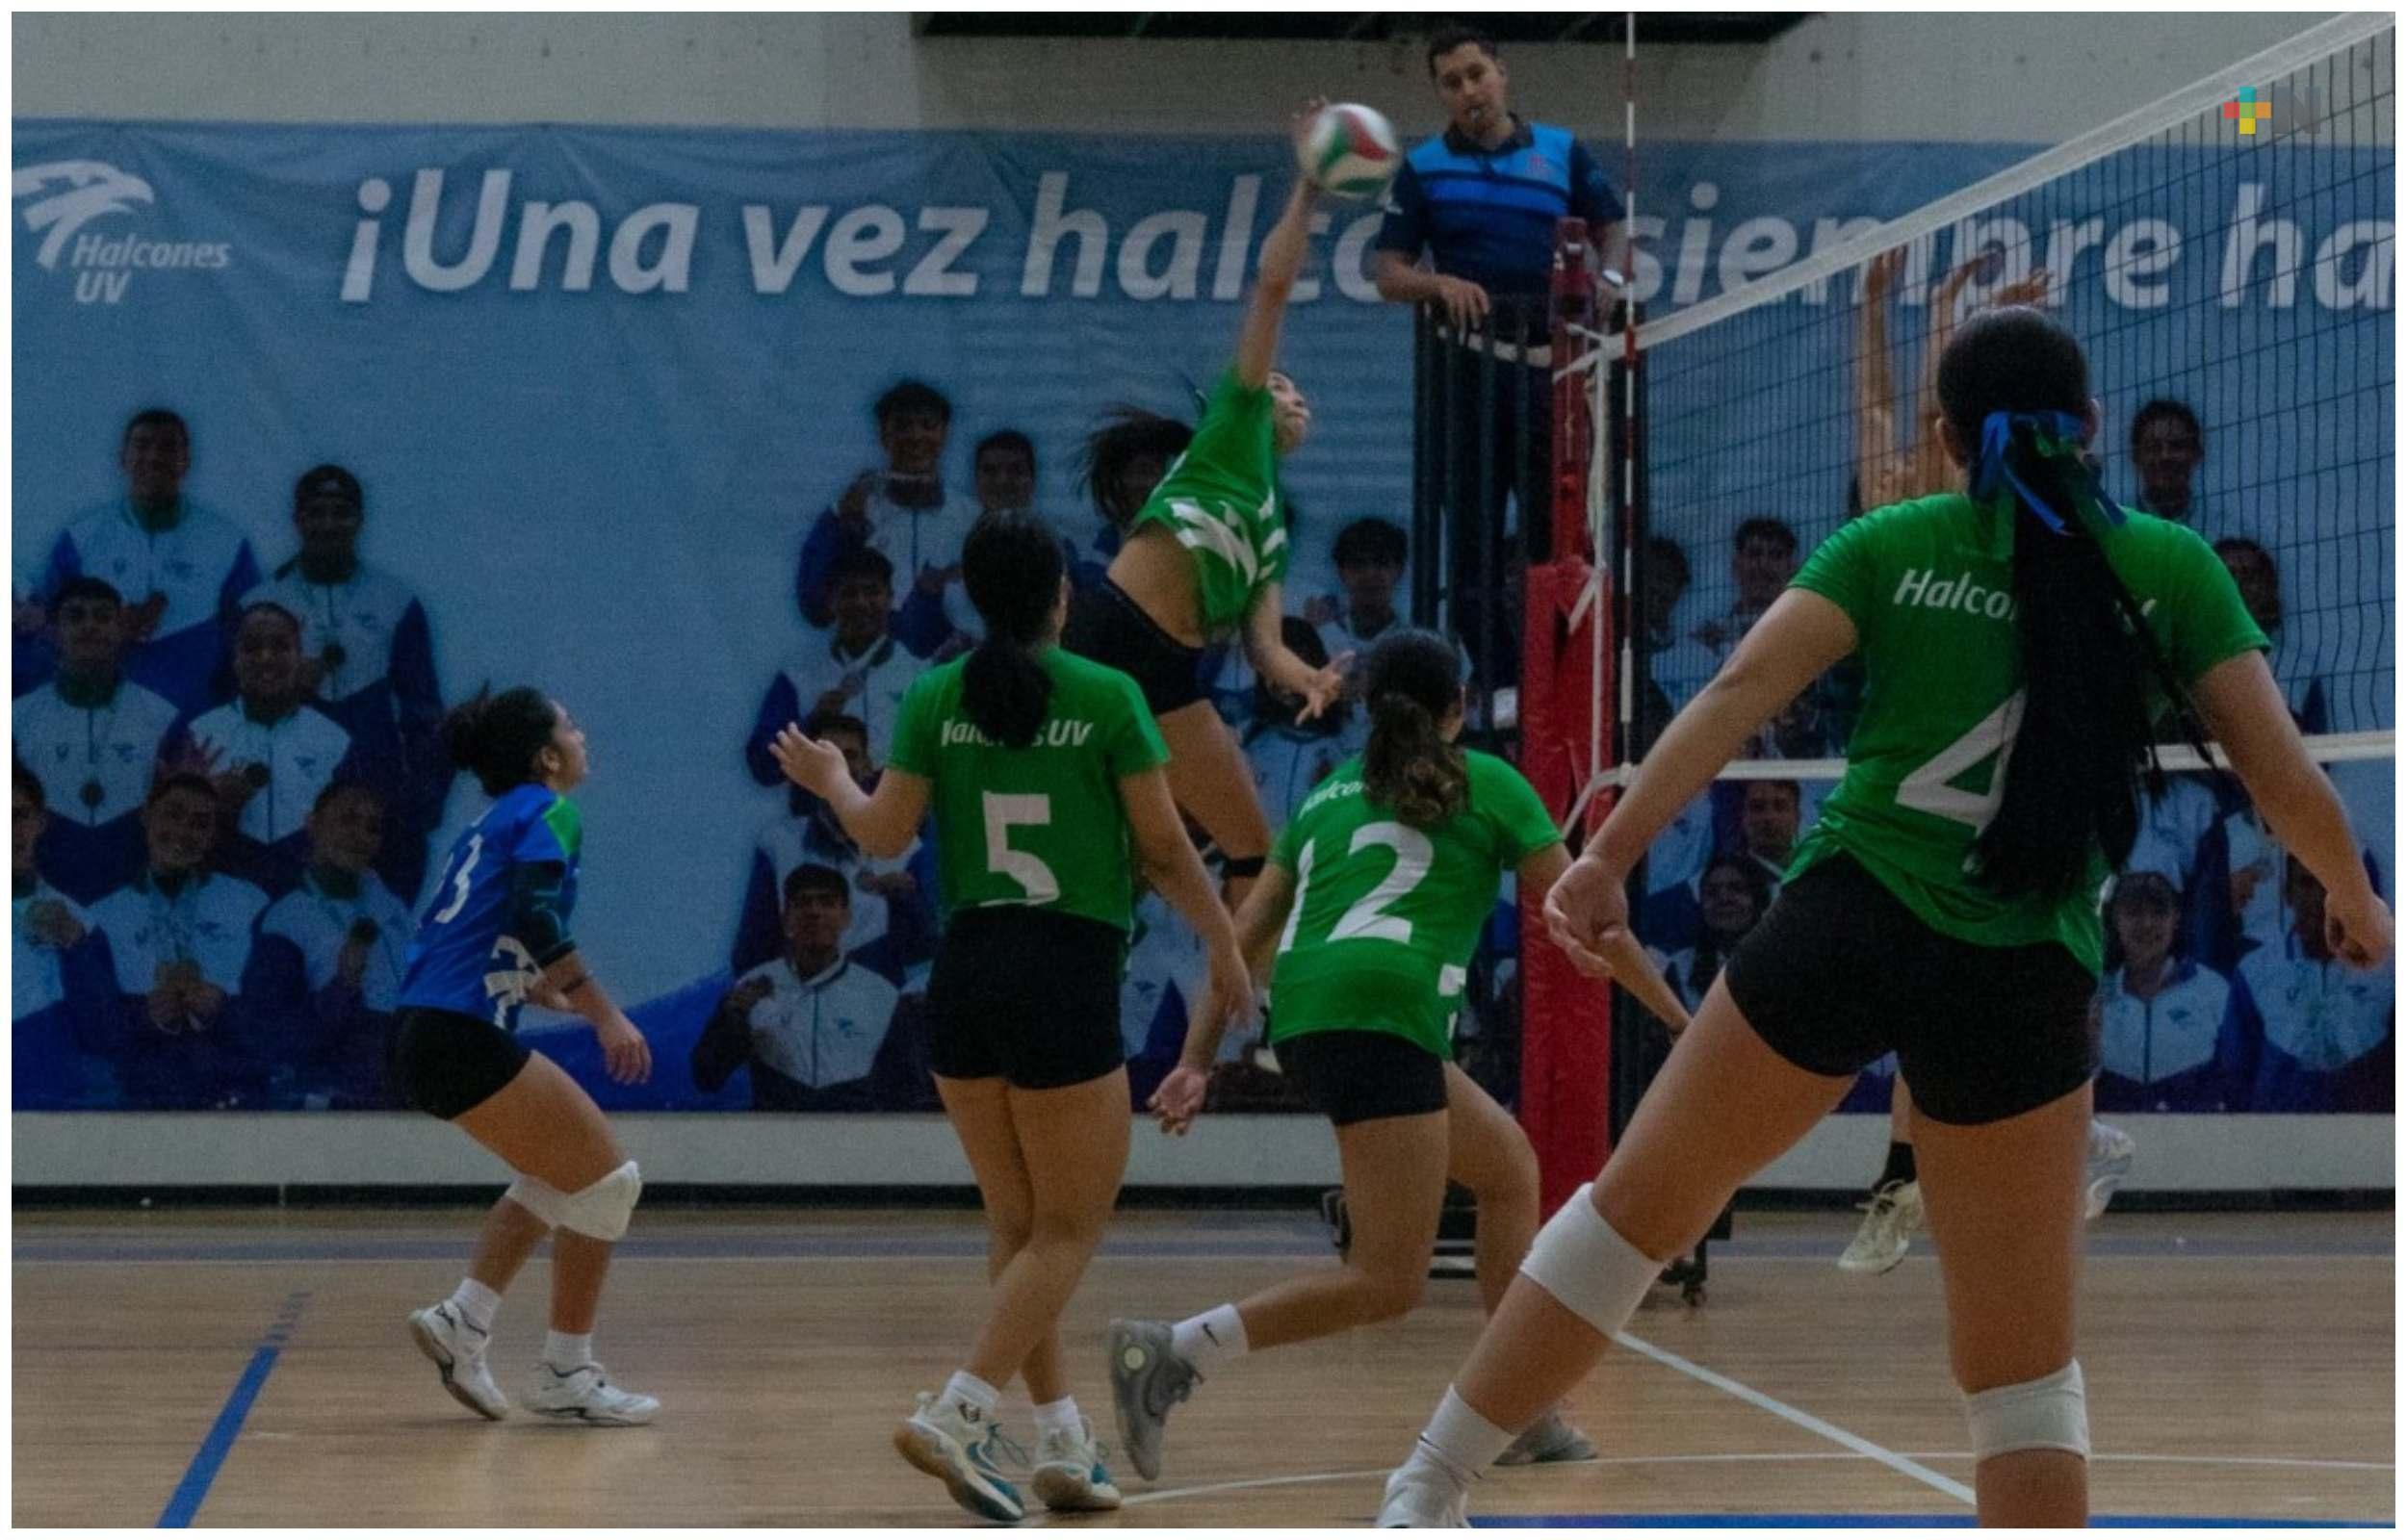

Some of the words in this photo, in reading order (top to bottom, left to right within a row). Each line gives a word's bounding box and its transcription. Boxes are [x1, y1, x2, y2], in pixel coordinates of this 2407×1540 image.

[71, 233, 232, 269] Halcones
[340, 168, 701, 302] ¡Una
[742, 205, 989, 295] vez
[75, 270, 131, 304] UV
[1893, 568, 2018, 622] Halco
[979, 789, 1060, 907] 5
[1276, 821, 1435, 956] 12
